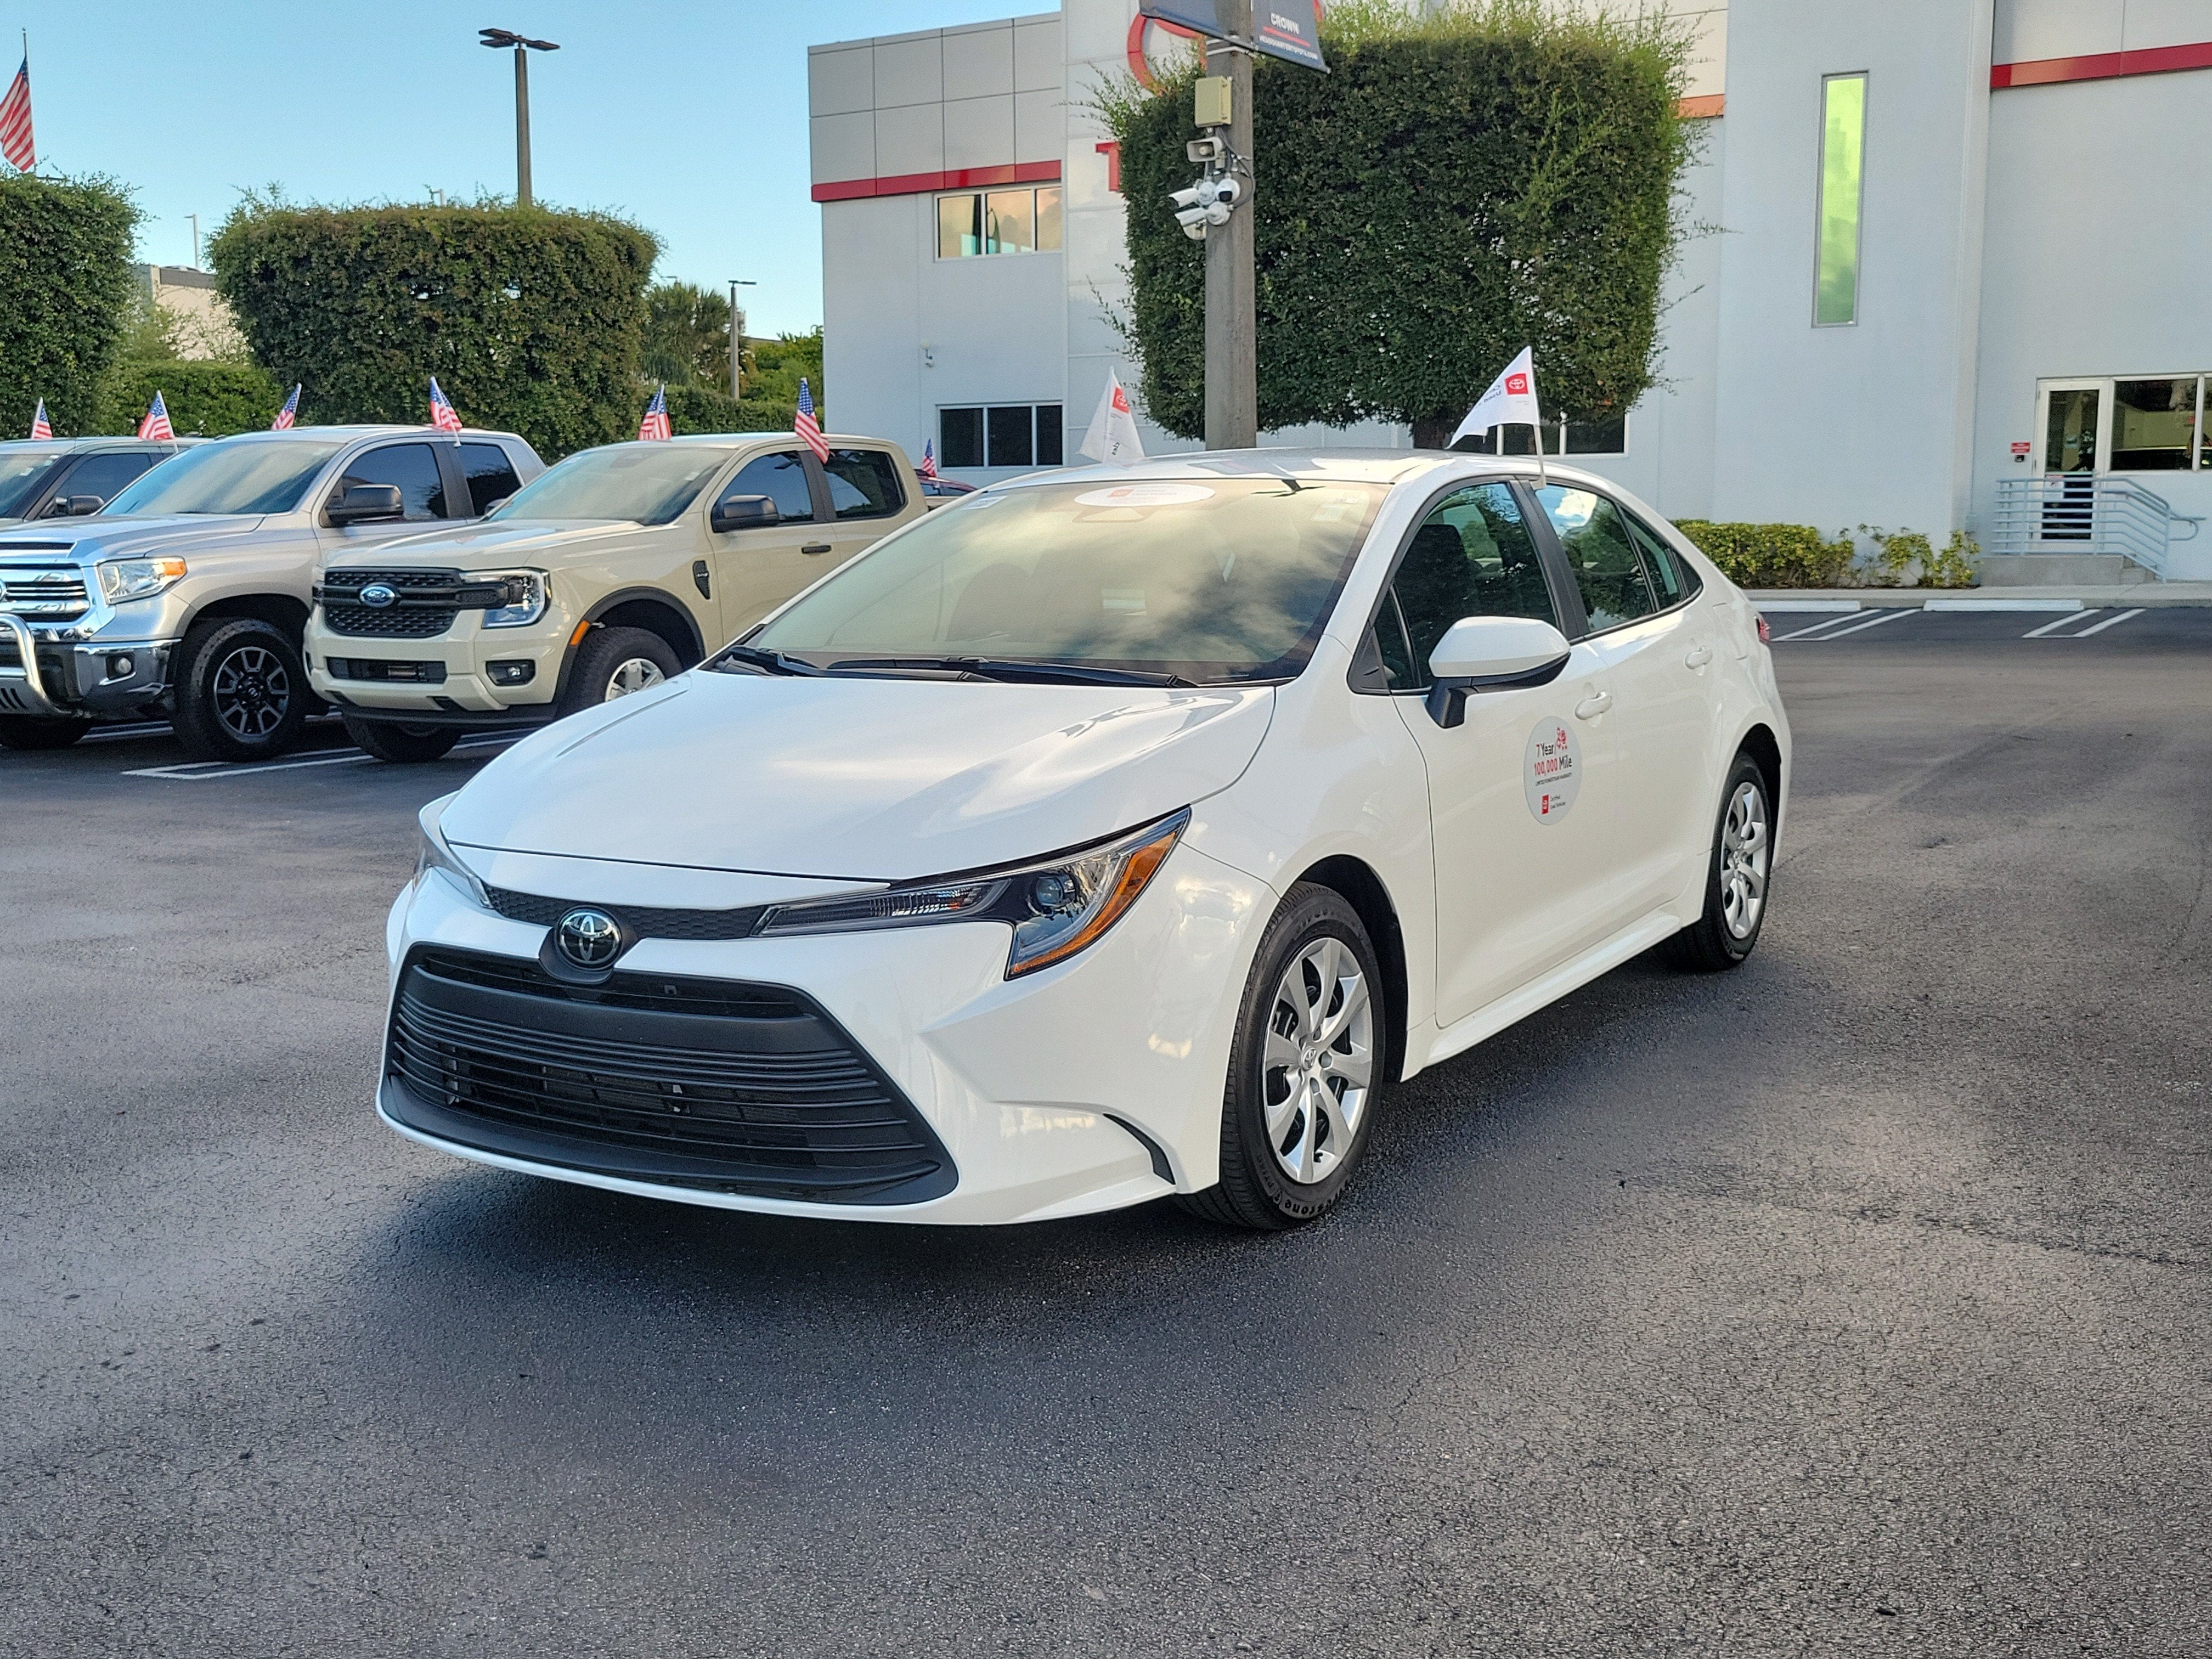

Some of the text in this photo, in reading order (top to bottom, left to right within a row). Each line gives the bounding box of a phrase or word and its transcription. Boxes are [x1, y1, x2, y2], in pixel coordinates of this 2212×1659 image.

[1270, 12, 1300, 35] CROWN
[1534, 754, 1572, 776] 100,000 Mile
